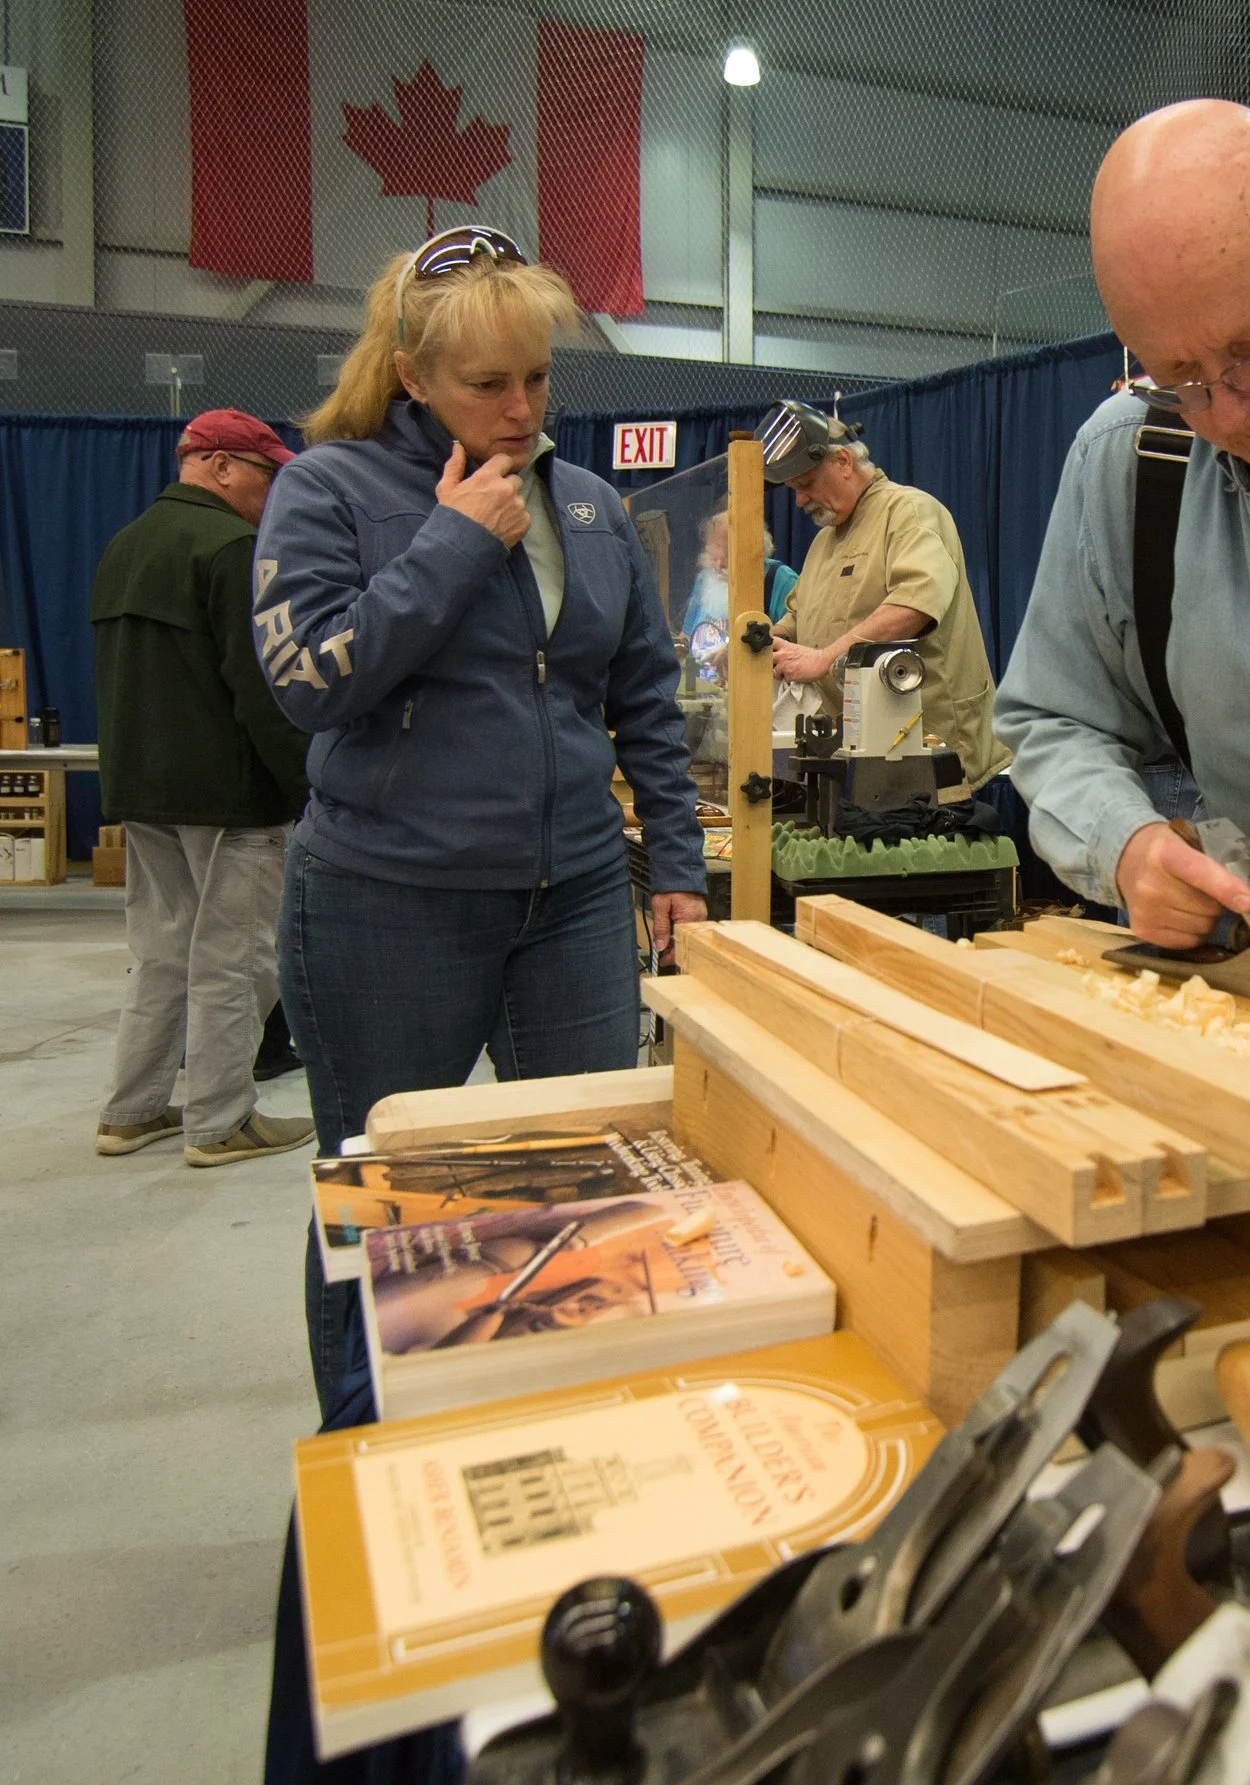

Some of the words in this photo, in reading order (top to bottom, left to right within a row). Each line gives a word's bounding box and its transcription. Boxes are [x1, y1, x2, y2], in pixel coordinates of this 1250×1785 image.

[621, 427, 668, 464] EXIT
[254, 559, 354, 690] ARIAT
[679, 1397, 781, 1527] COMPANION
